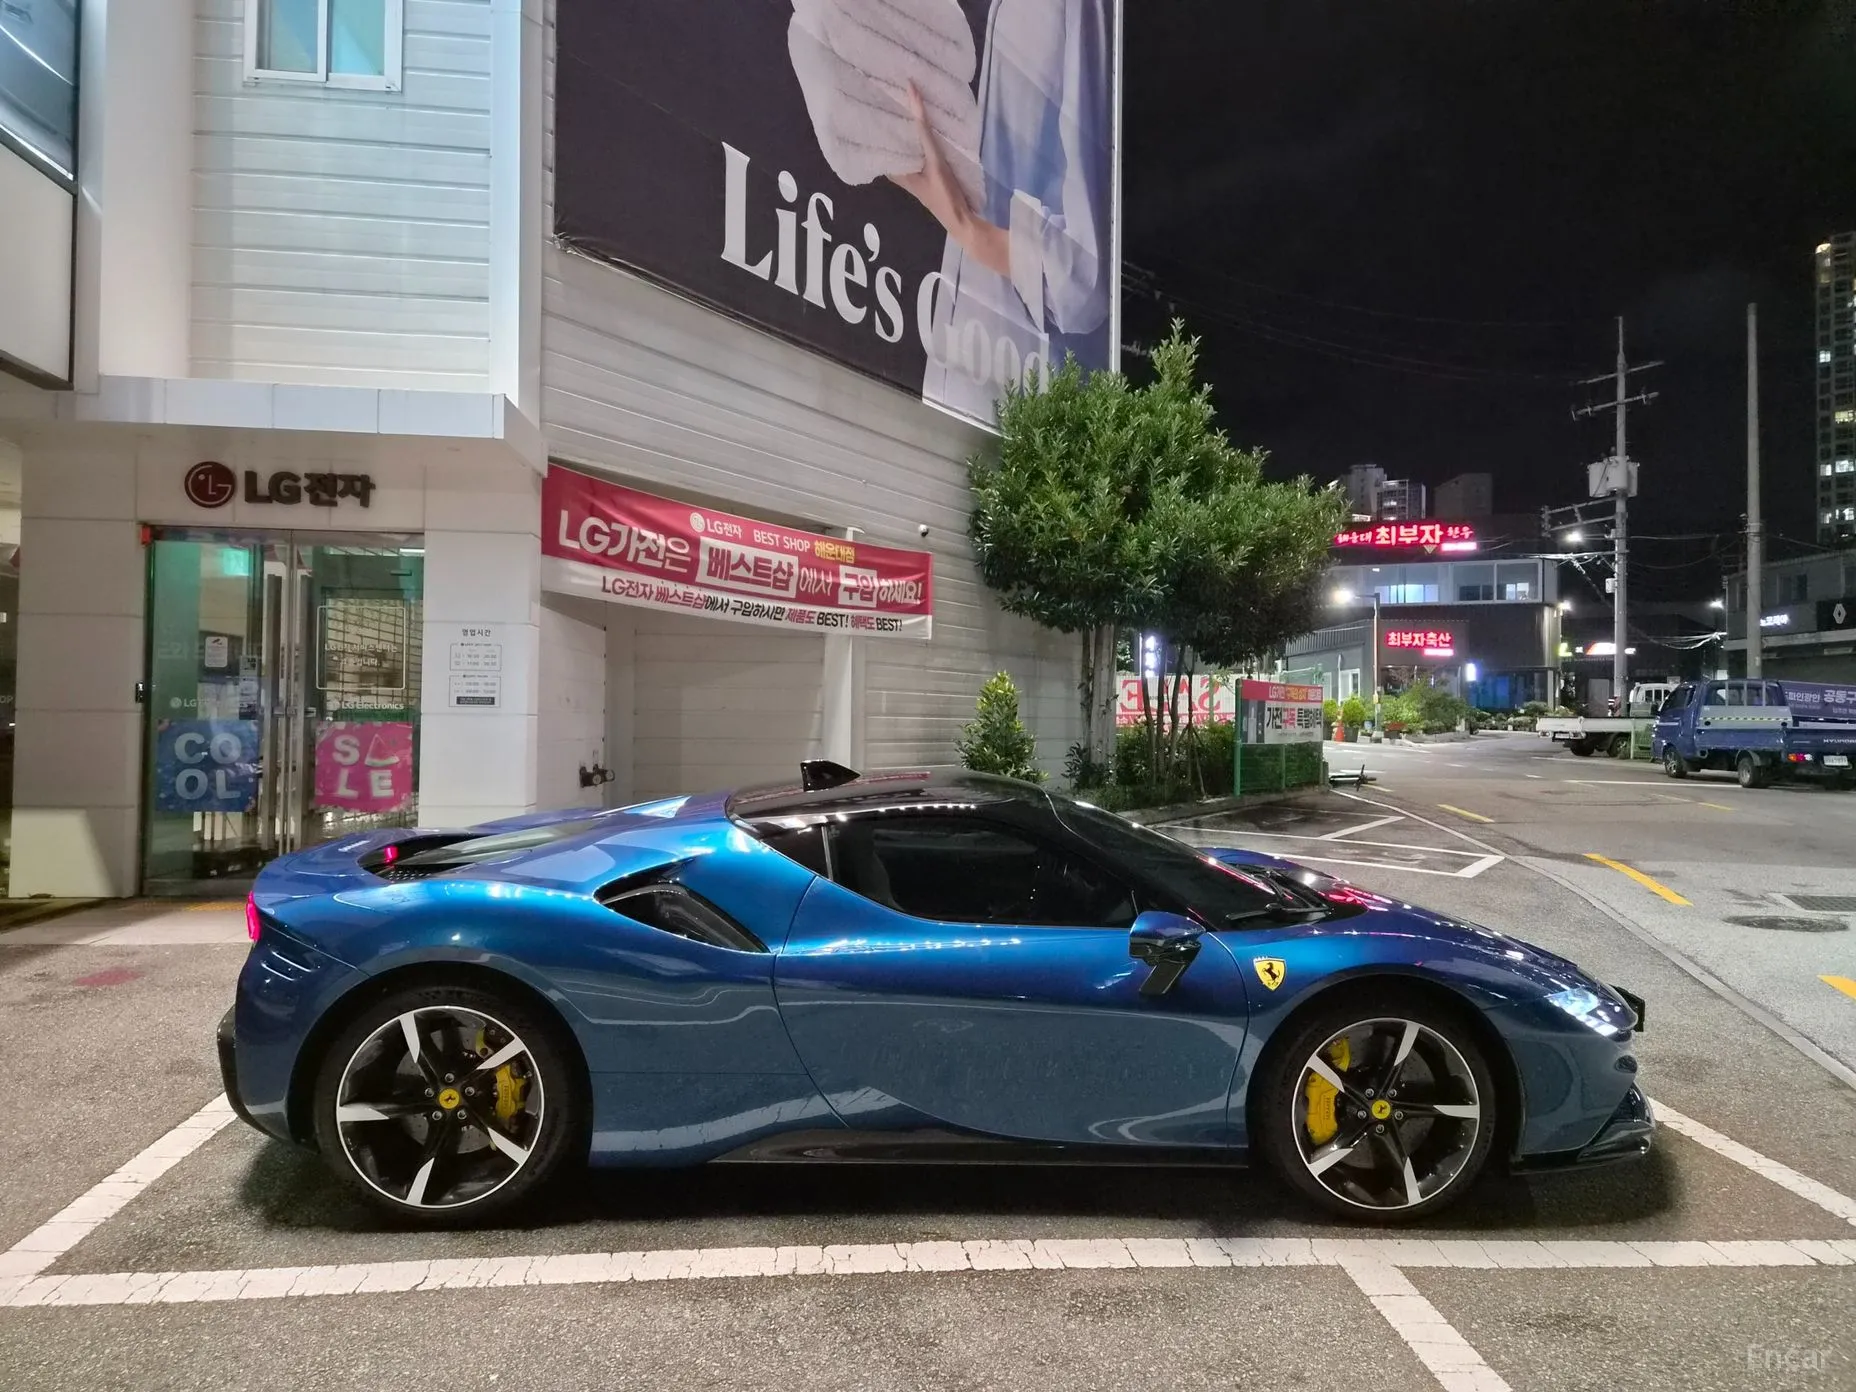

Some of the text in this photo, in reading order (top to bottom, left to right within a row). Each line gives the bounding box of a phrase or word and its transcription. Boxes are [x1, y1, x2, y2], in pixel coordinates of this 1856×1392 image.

[720, 141, 904, 344] Life's
[244, 470, 377, 508] LG전자
[558, 509, 691, 573] LG가전은
[706, 518, 742, 539] LG전자
[753, 529, 780, 547] BEST
[783, 536, 811, 552] SHOP
[1375, 524, 1443, 546] 최부자
[602, 576, 653, 600] LG전자
[731, 600, 786, 621] 구입하시면
[816, 612, 849, 628] BEST!
[876, 617, 902, 632] BEST!
[462, 628, 491, 637] 영업시간
[1387, 631, 1452, 647] 최부자축산
[355, 701, 404, 710] Electronics
